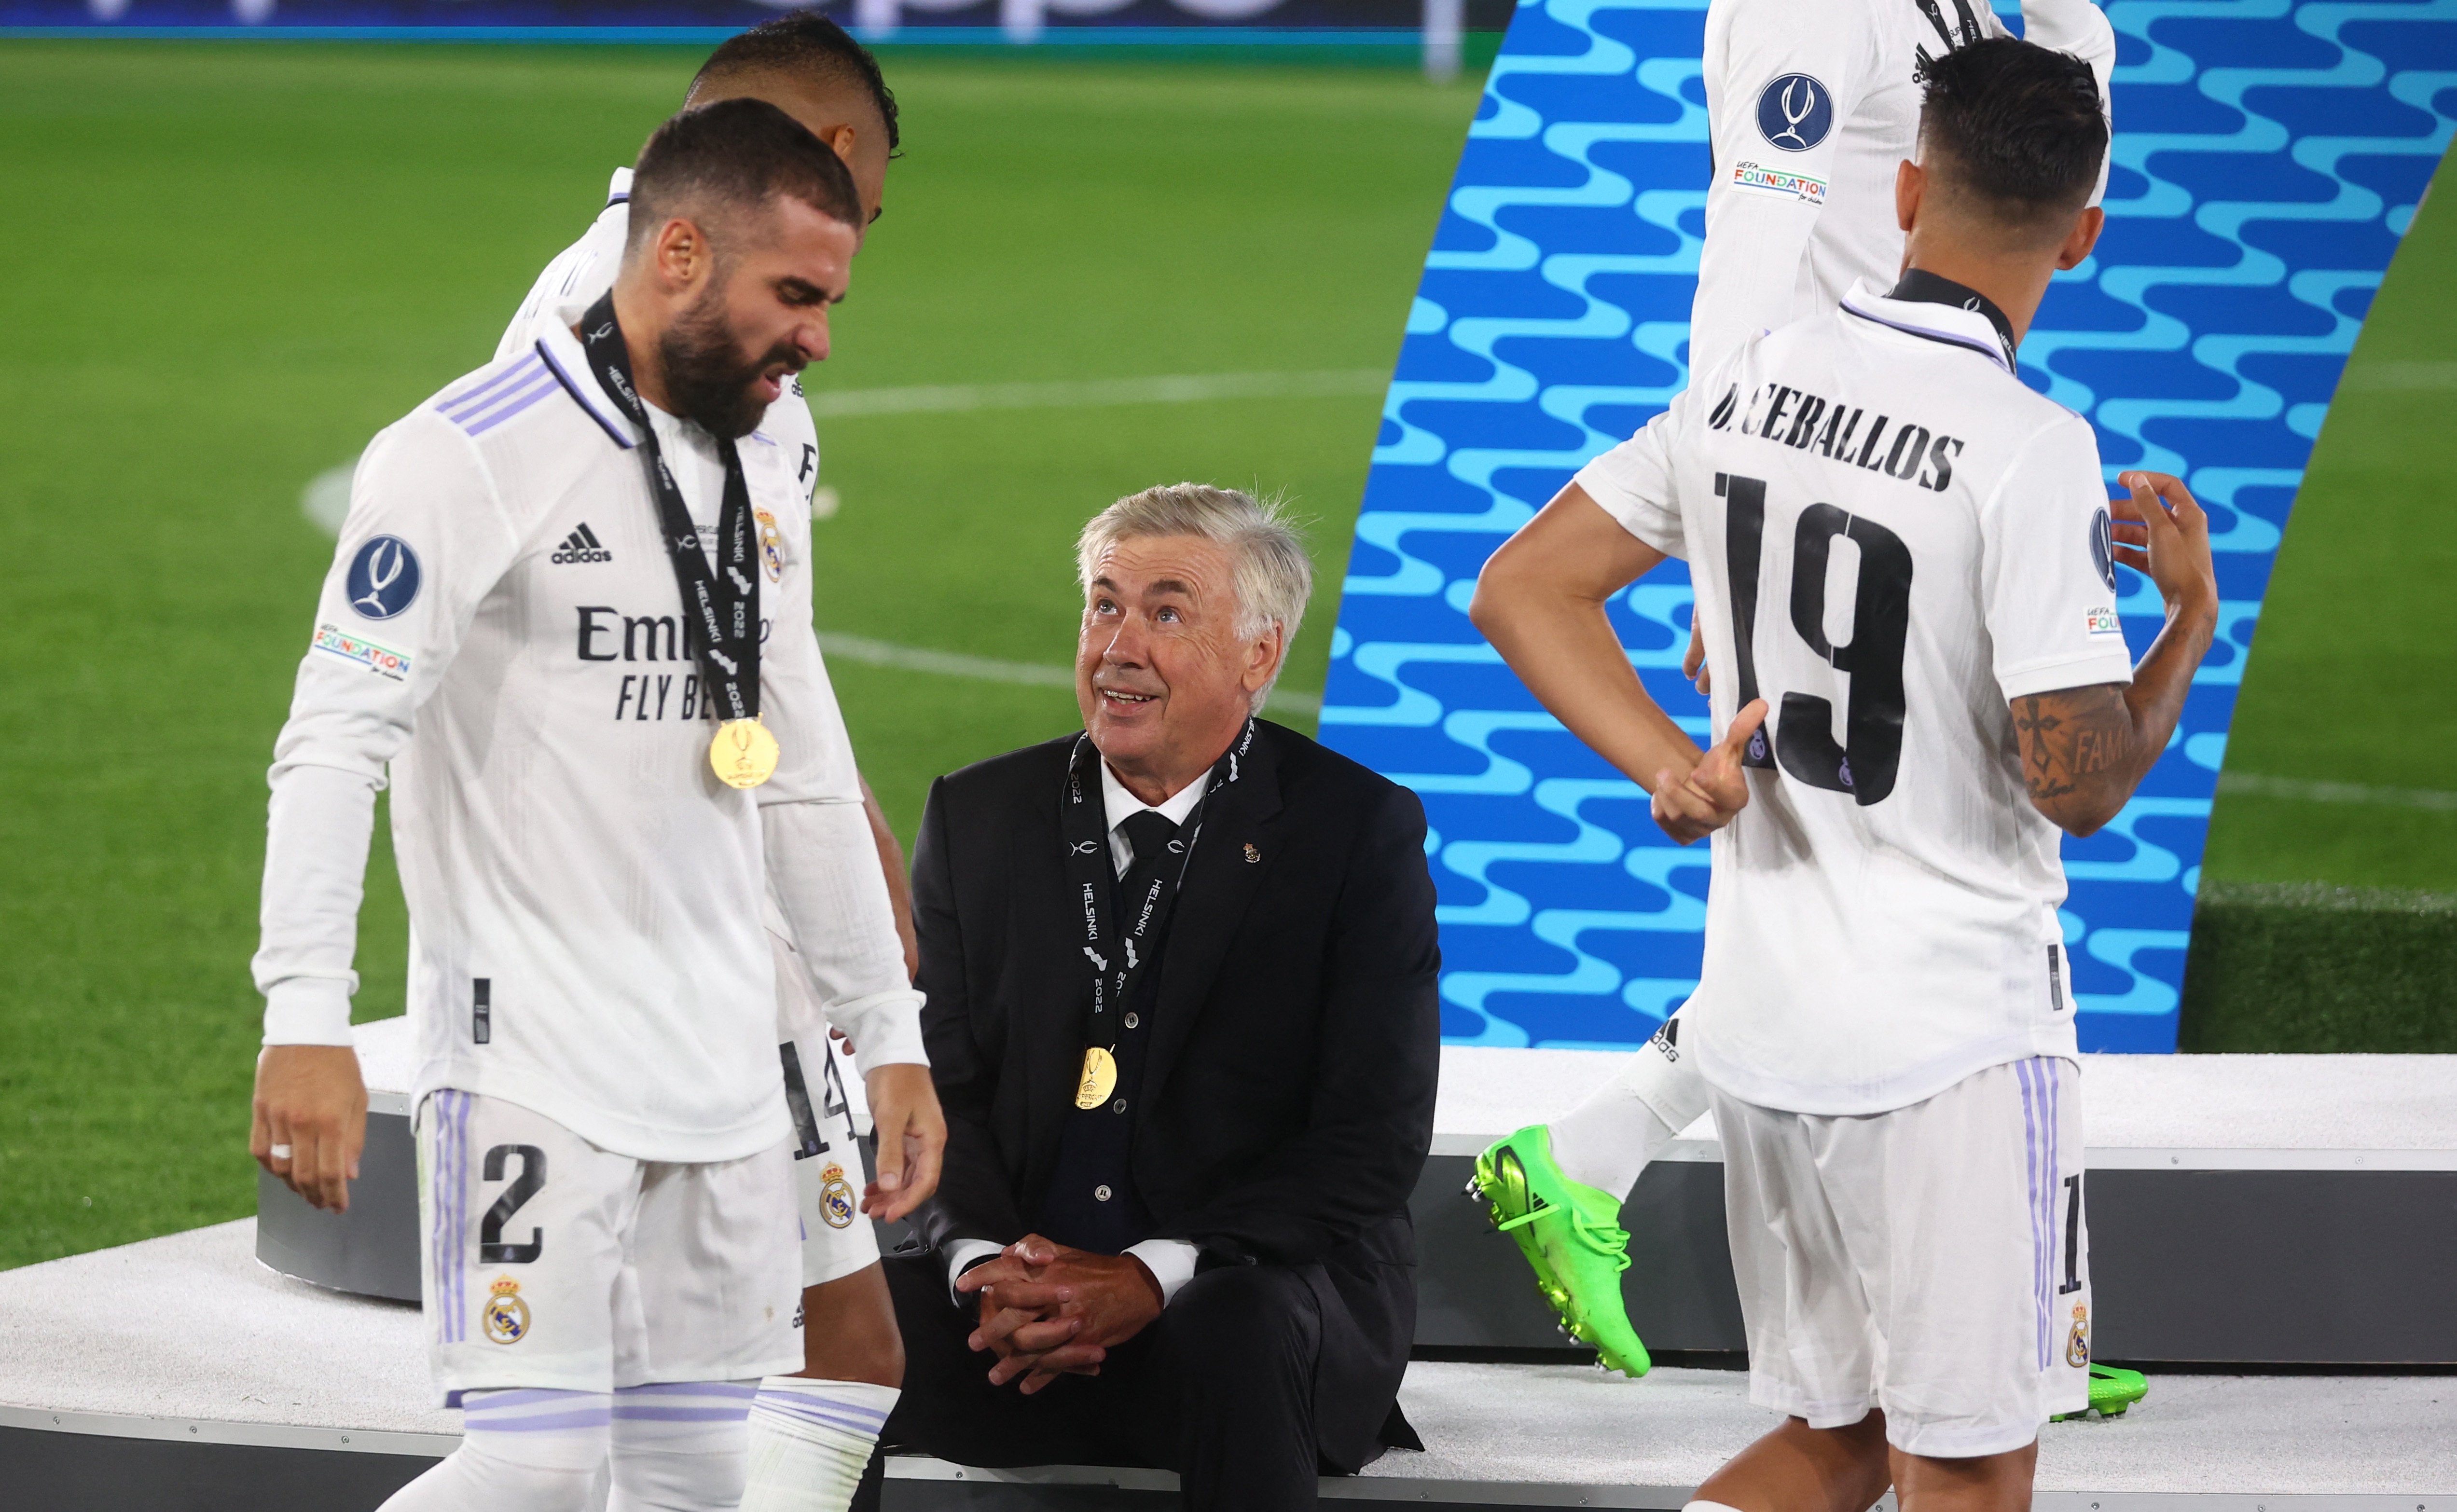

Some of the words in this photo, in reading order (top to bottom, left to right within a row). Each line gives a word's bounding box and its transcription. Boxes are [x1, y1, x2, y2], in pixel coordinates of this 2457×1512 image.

[1734, 169, 1826, 197] FOUNDATION
[1737, 161, 1758, 170] UEFA
[1740, 383, 1965, 492] CEBALLOS
[552, 548, 612, 564] adidas
[695, 580, 722, 643] HELSINKI
[733, 602, 745, 639] 2022
[2087, 607, 2110, 616] UEFA
[315, 631, 410, 673] FOUNDATION
[1715, 472, 1913, 806] 19
[615, 674, 672, 720] FLY
[726, 681, 746, 718] 2022
[1239, 716, 1255, 756] HELSINKI
[1071, 773, 1082, 804] 2022
[1083, 883, 1098, 940] HELSINKI
[1134, 879, 1162, 936] HELSINKI
[779, 1033, 856, 1160] 14
[481, 1144, 547, 1264] 2
